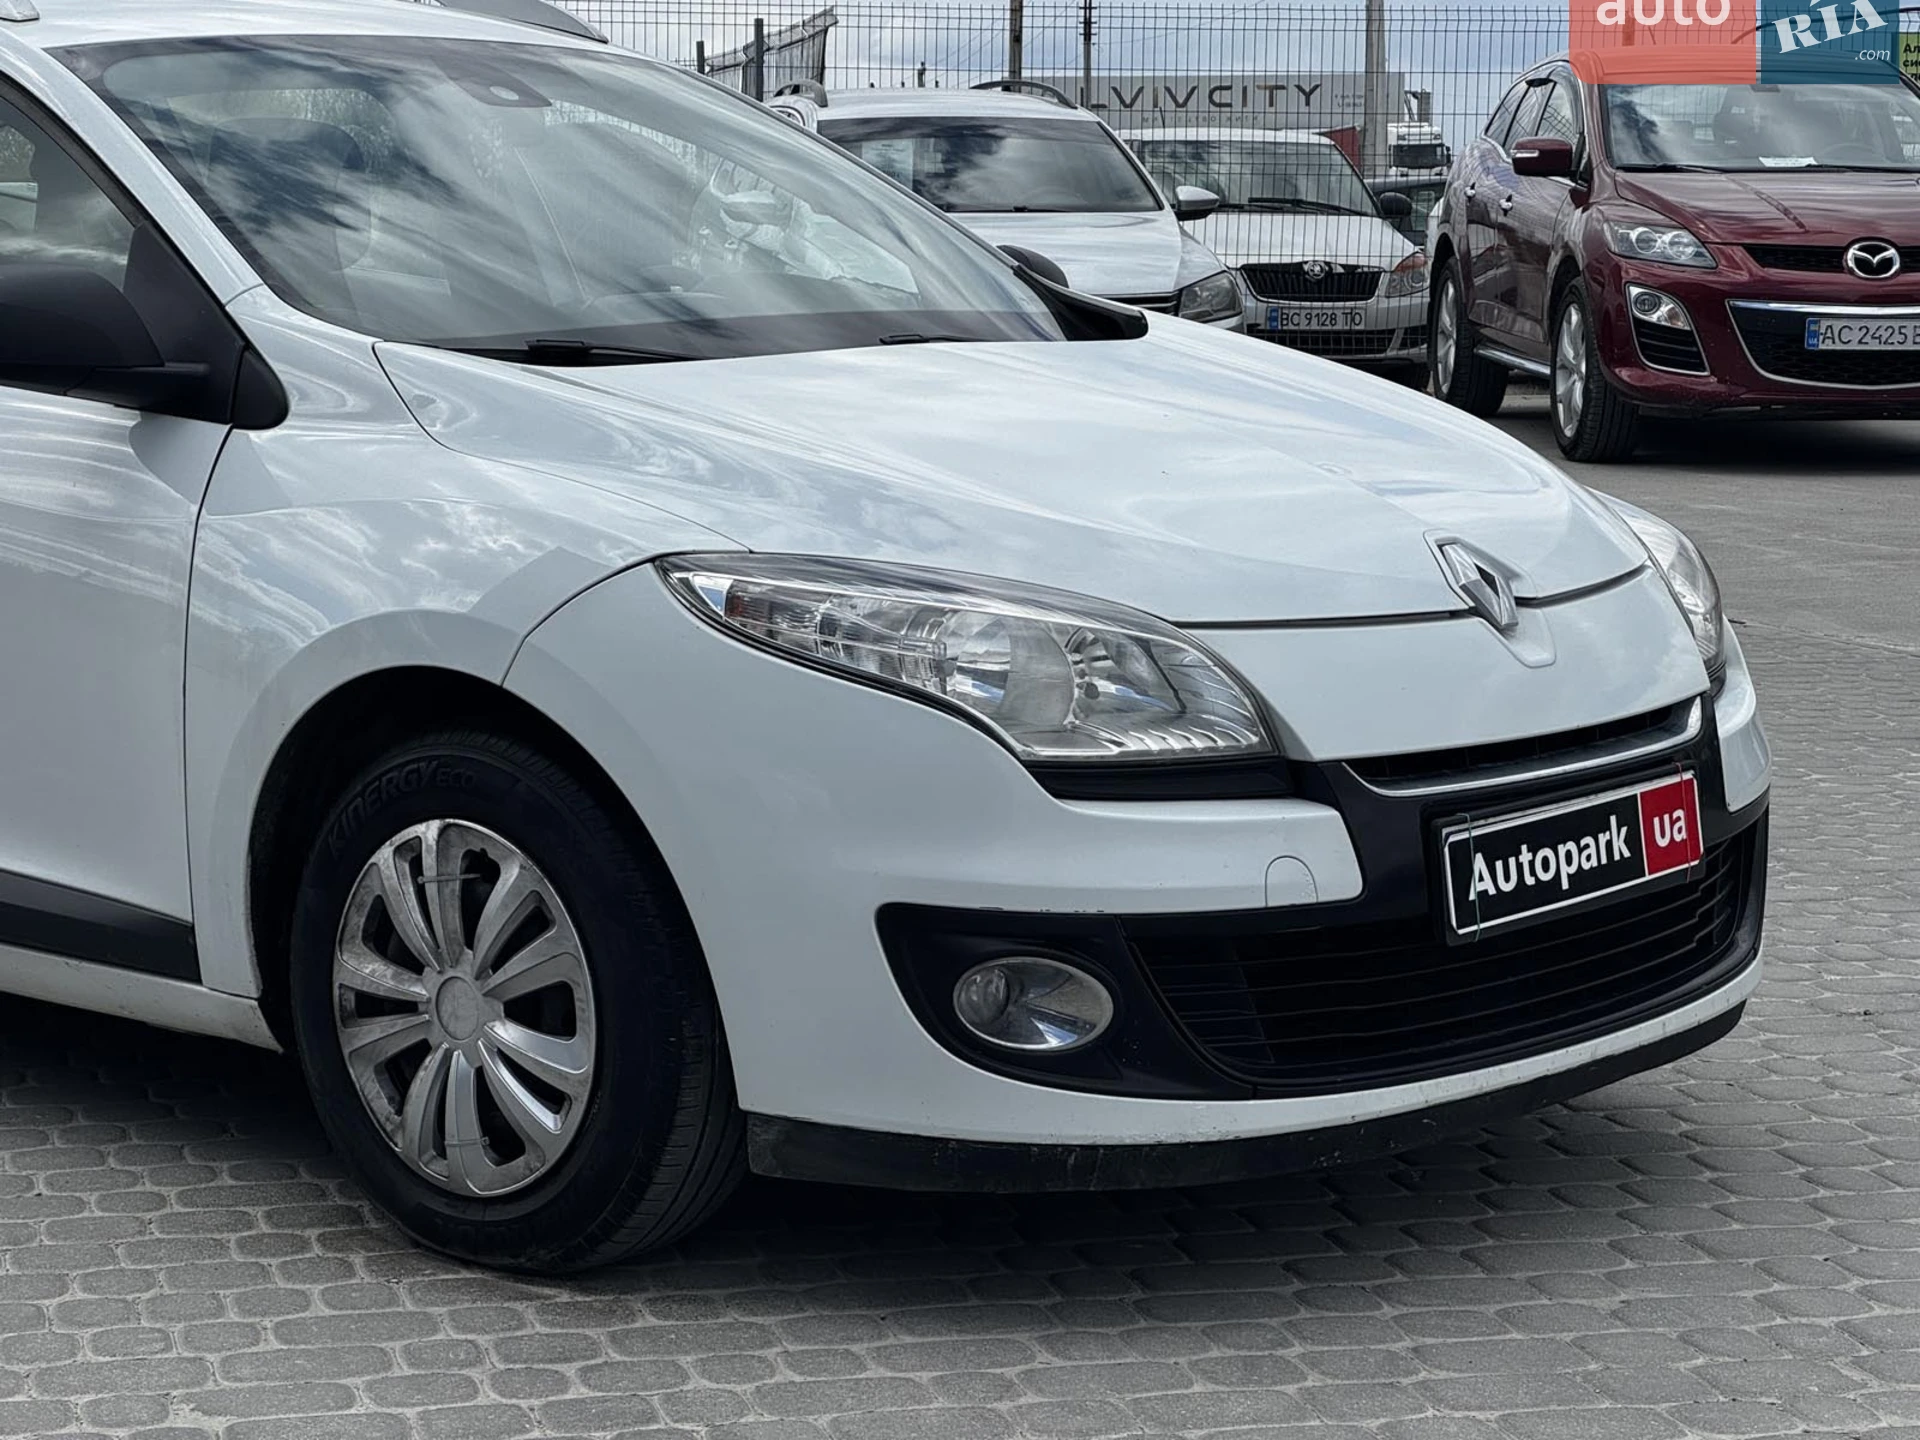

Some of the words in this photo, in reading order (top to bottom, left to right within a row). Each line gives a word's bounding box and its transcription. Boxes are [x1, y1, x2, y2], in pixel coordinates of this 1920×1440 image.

[1080, 83, 1322, 109] LVIVCITY
[1280, 311, 1300, 327] BC
[1304, 312, 1337, 327] 9128
[1341, 311, 1363, 327] TO
[1821, 324, 1853, 345] AC
[1857, 324, 1908, 346] 2425
[1468, 814, 1632, 901] Autopark
[1653, 808, 1688, 847] ua
